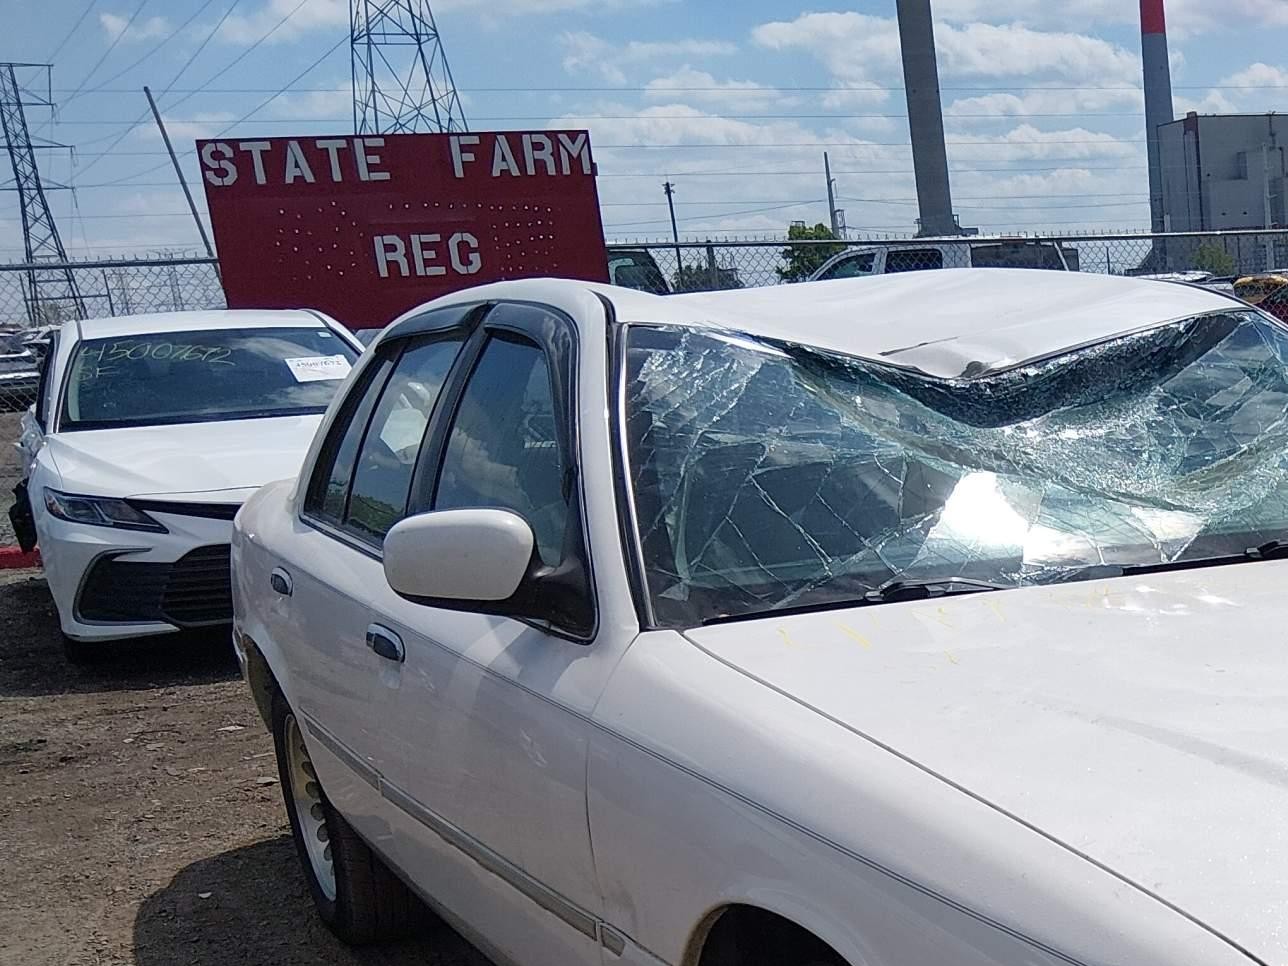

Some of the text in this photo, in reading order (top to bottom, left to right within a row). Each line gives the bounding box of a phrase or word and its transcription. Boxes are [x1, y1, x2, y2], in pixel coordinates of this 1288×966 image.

[201, 133, 592, 187] STATE FARM
[373, 232, 482, 278] REG
